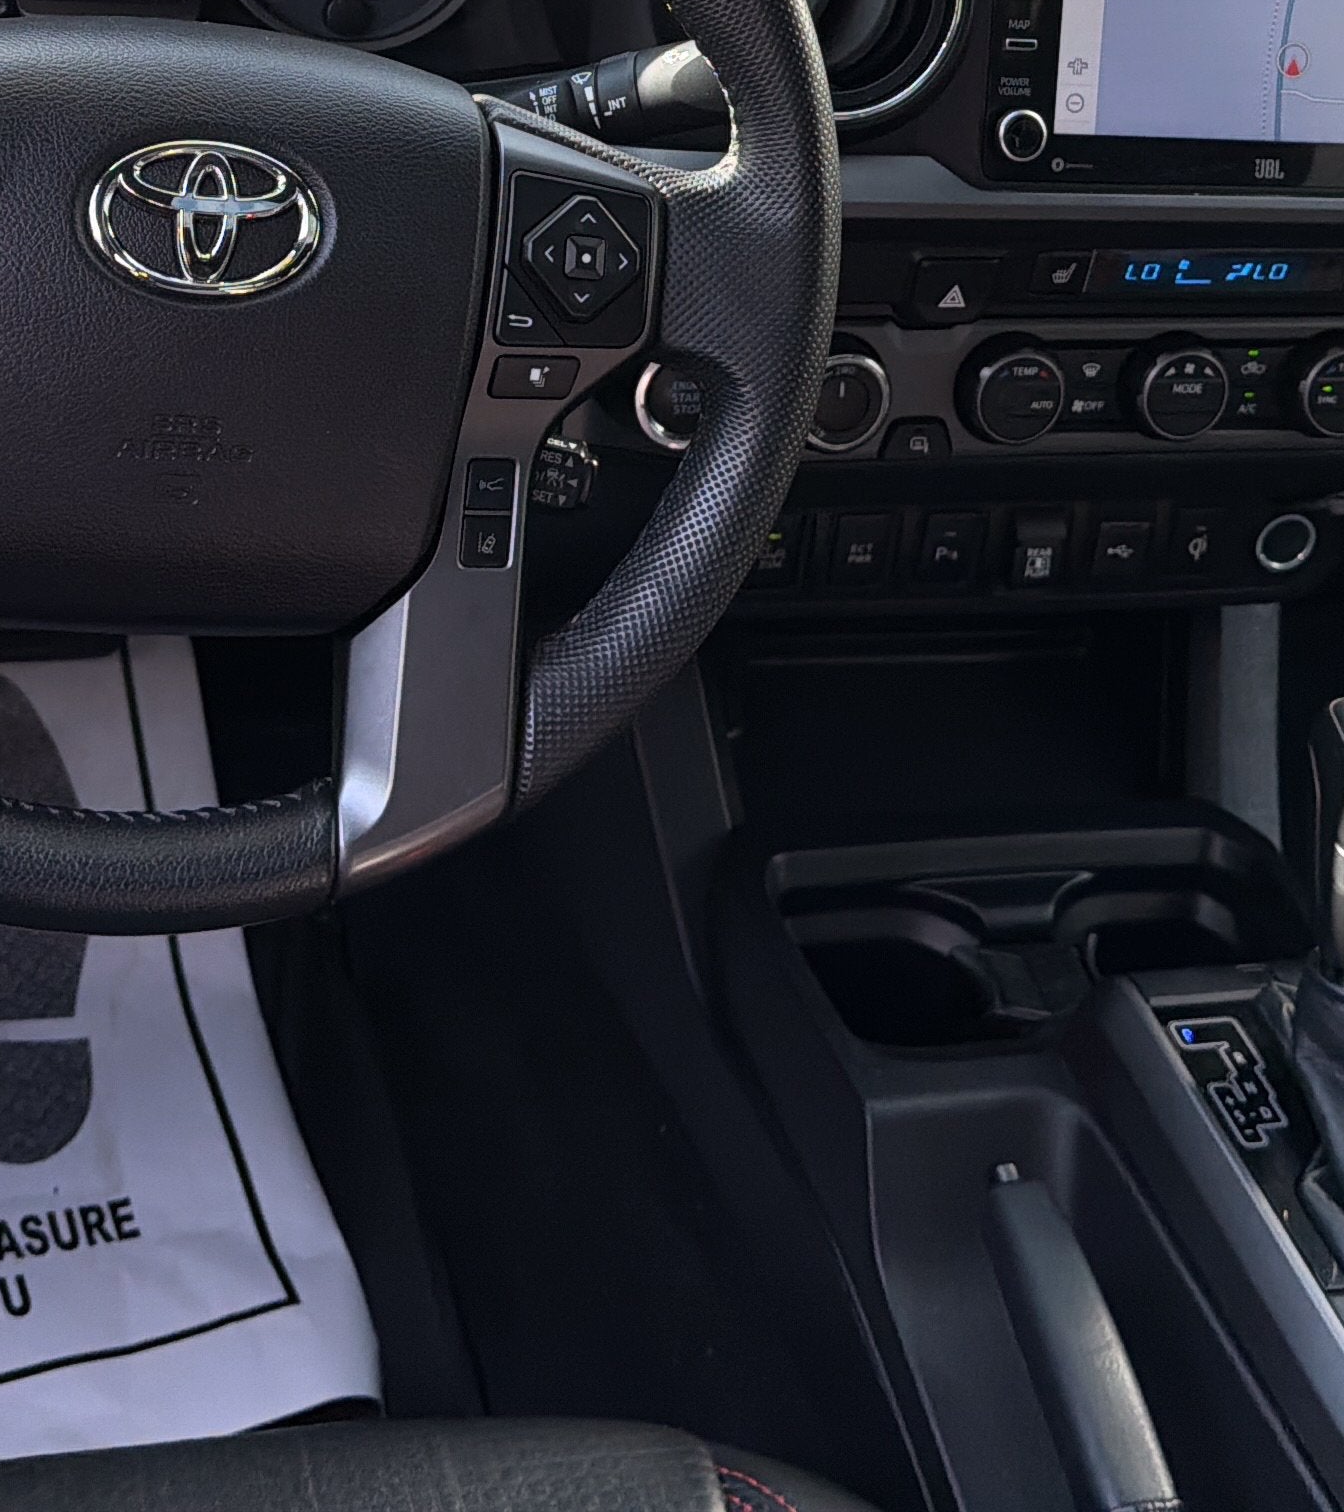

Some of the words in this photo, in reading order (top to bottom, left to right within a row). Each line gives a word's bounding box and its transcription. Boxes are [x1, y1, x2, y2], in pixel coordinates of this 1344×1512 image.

[1008, 20, 1031, 30] MAP
[1000, 77, 1030, 88] POWER
[998, 87, 1032, 97] VOLUME
[608, 96, 627, 110] INT
[1257, 158, 1285, 180] JBL
[1012, 366, 1039, 377] TEMP
[1172, 383, 1203, 395] MODE
[1030, 400, 1053, 410] AUTO
[1083, 400, 1105, 412] OFF
[1237, 403, 1257, 415] A/C
[540, 449, 562, 464] RES
[532, 489, 554, 503] SET
